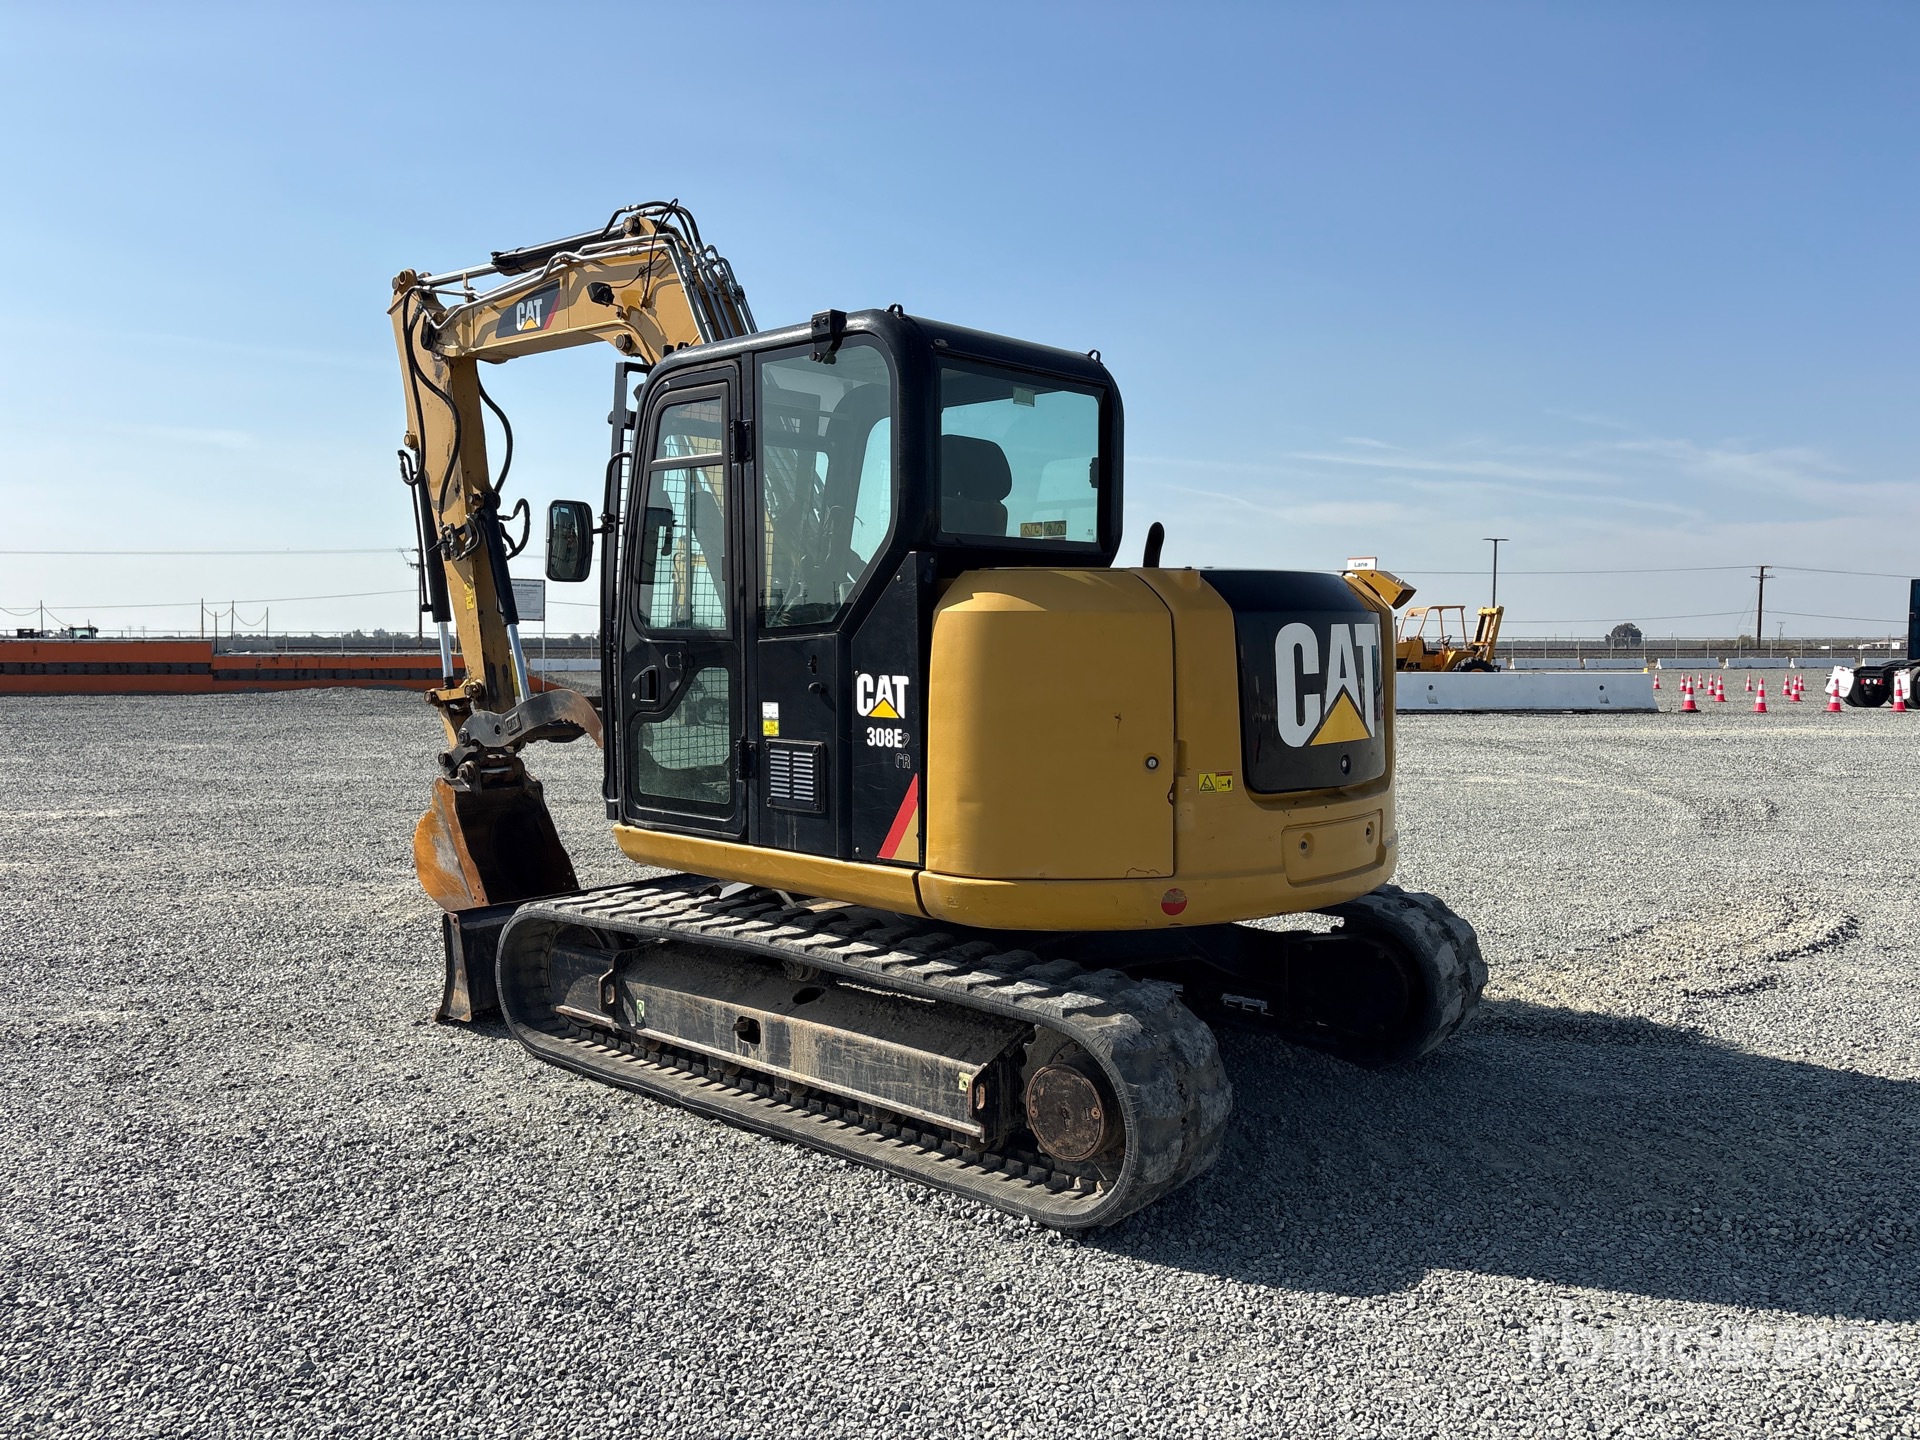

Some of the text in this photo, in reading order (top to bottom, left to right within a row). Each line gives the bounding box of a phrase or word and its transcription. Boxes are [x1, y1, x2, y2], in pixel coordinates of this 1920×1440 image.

[516, 298, 543, 331] CAT
[856, 673, 910, 719] CAT
[1274, 622, 1377, 748] CAT
